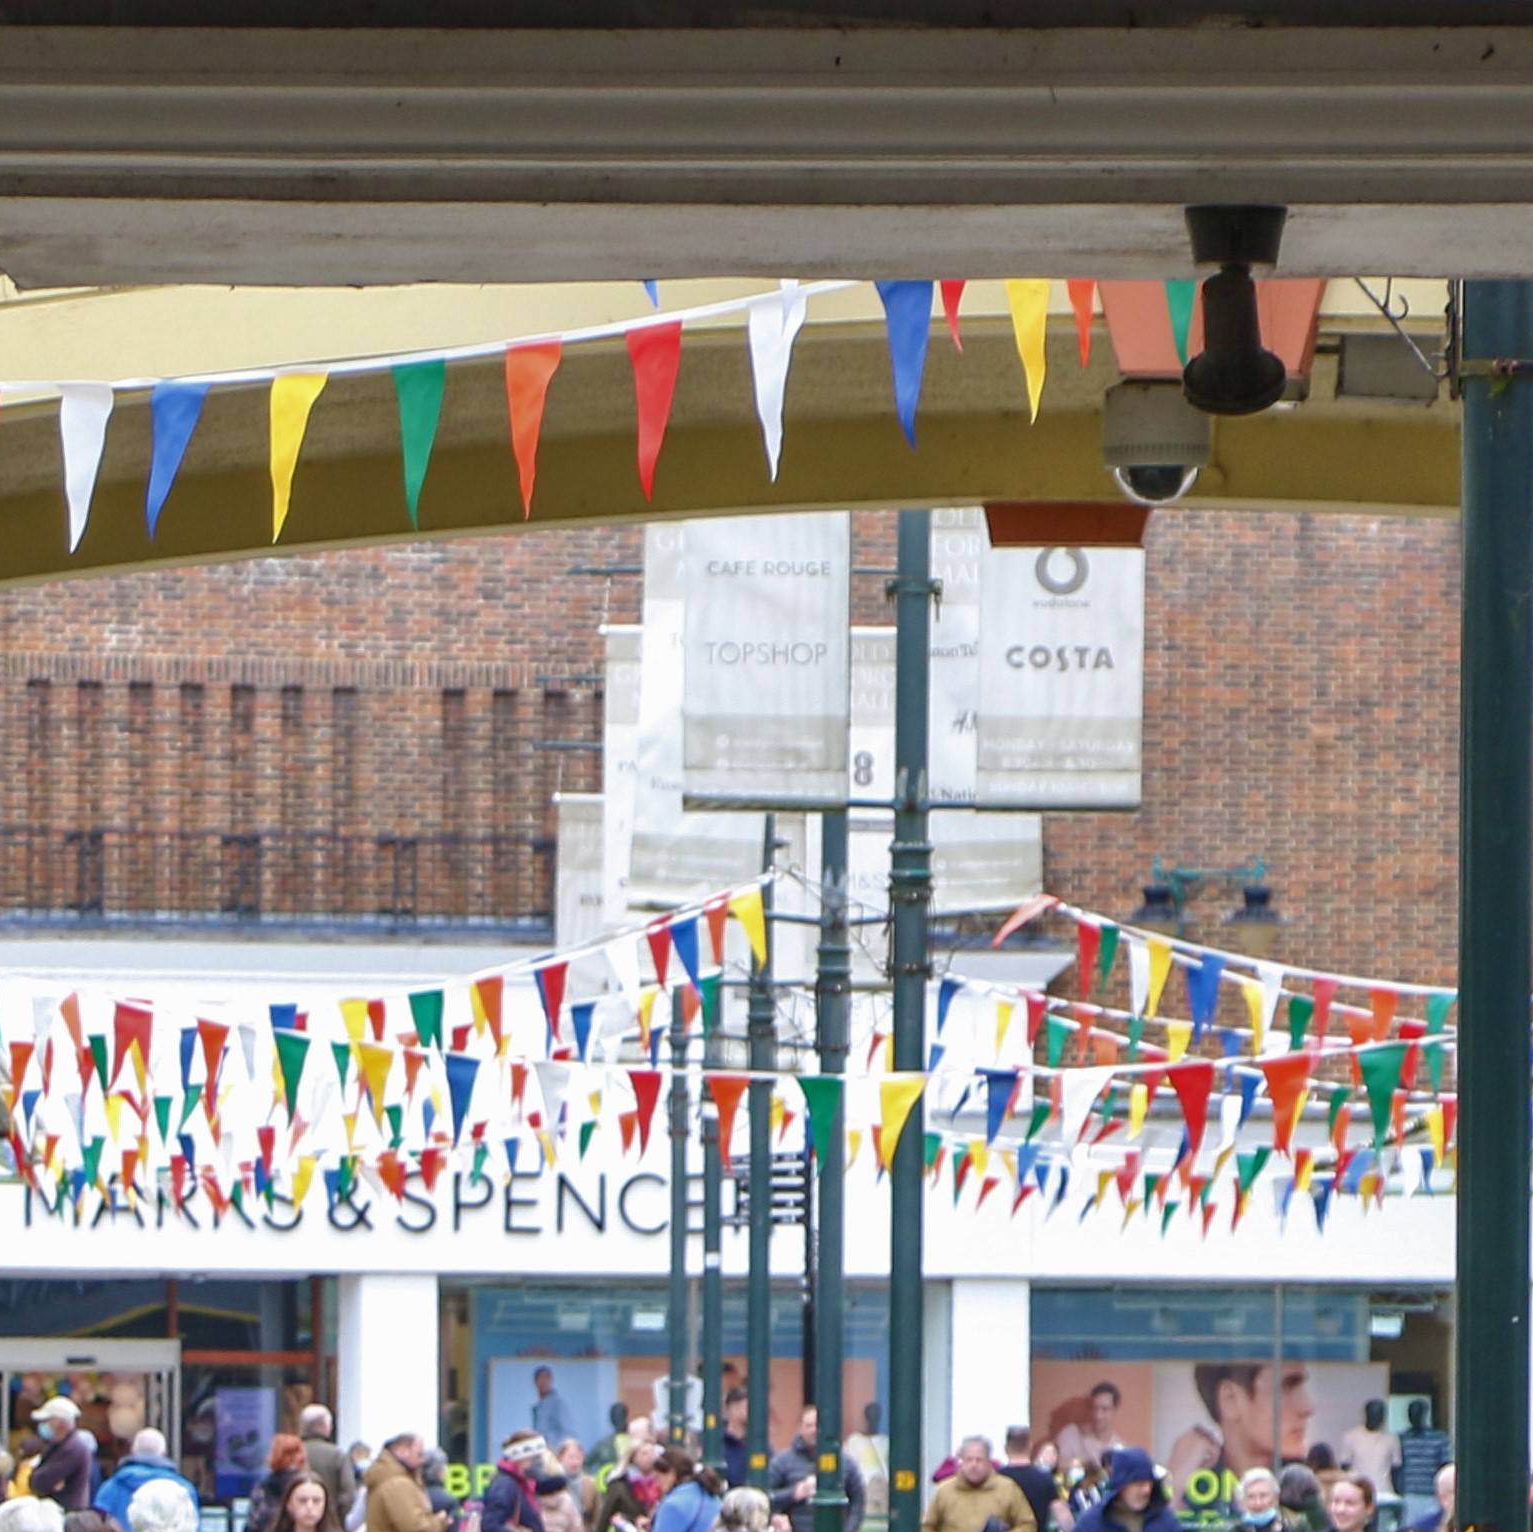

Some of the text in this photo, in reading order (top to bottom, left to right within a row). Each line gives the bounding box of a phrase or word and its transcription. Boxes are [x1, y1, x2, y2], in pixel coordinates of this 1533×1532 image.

[764, 560, 831, 577] ROUGE
[704, 641, 828, 666] TOPSHOP
[1006, 644, 1115, 672] COSTA
